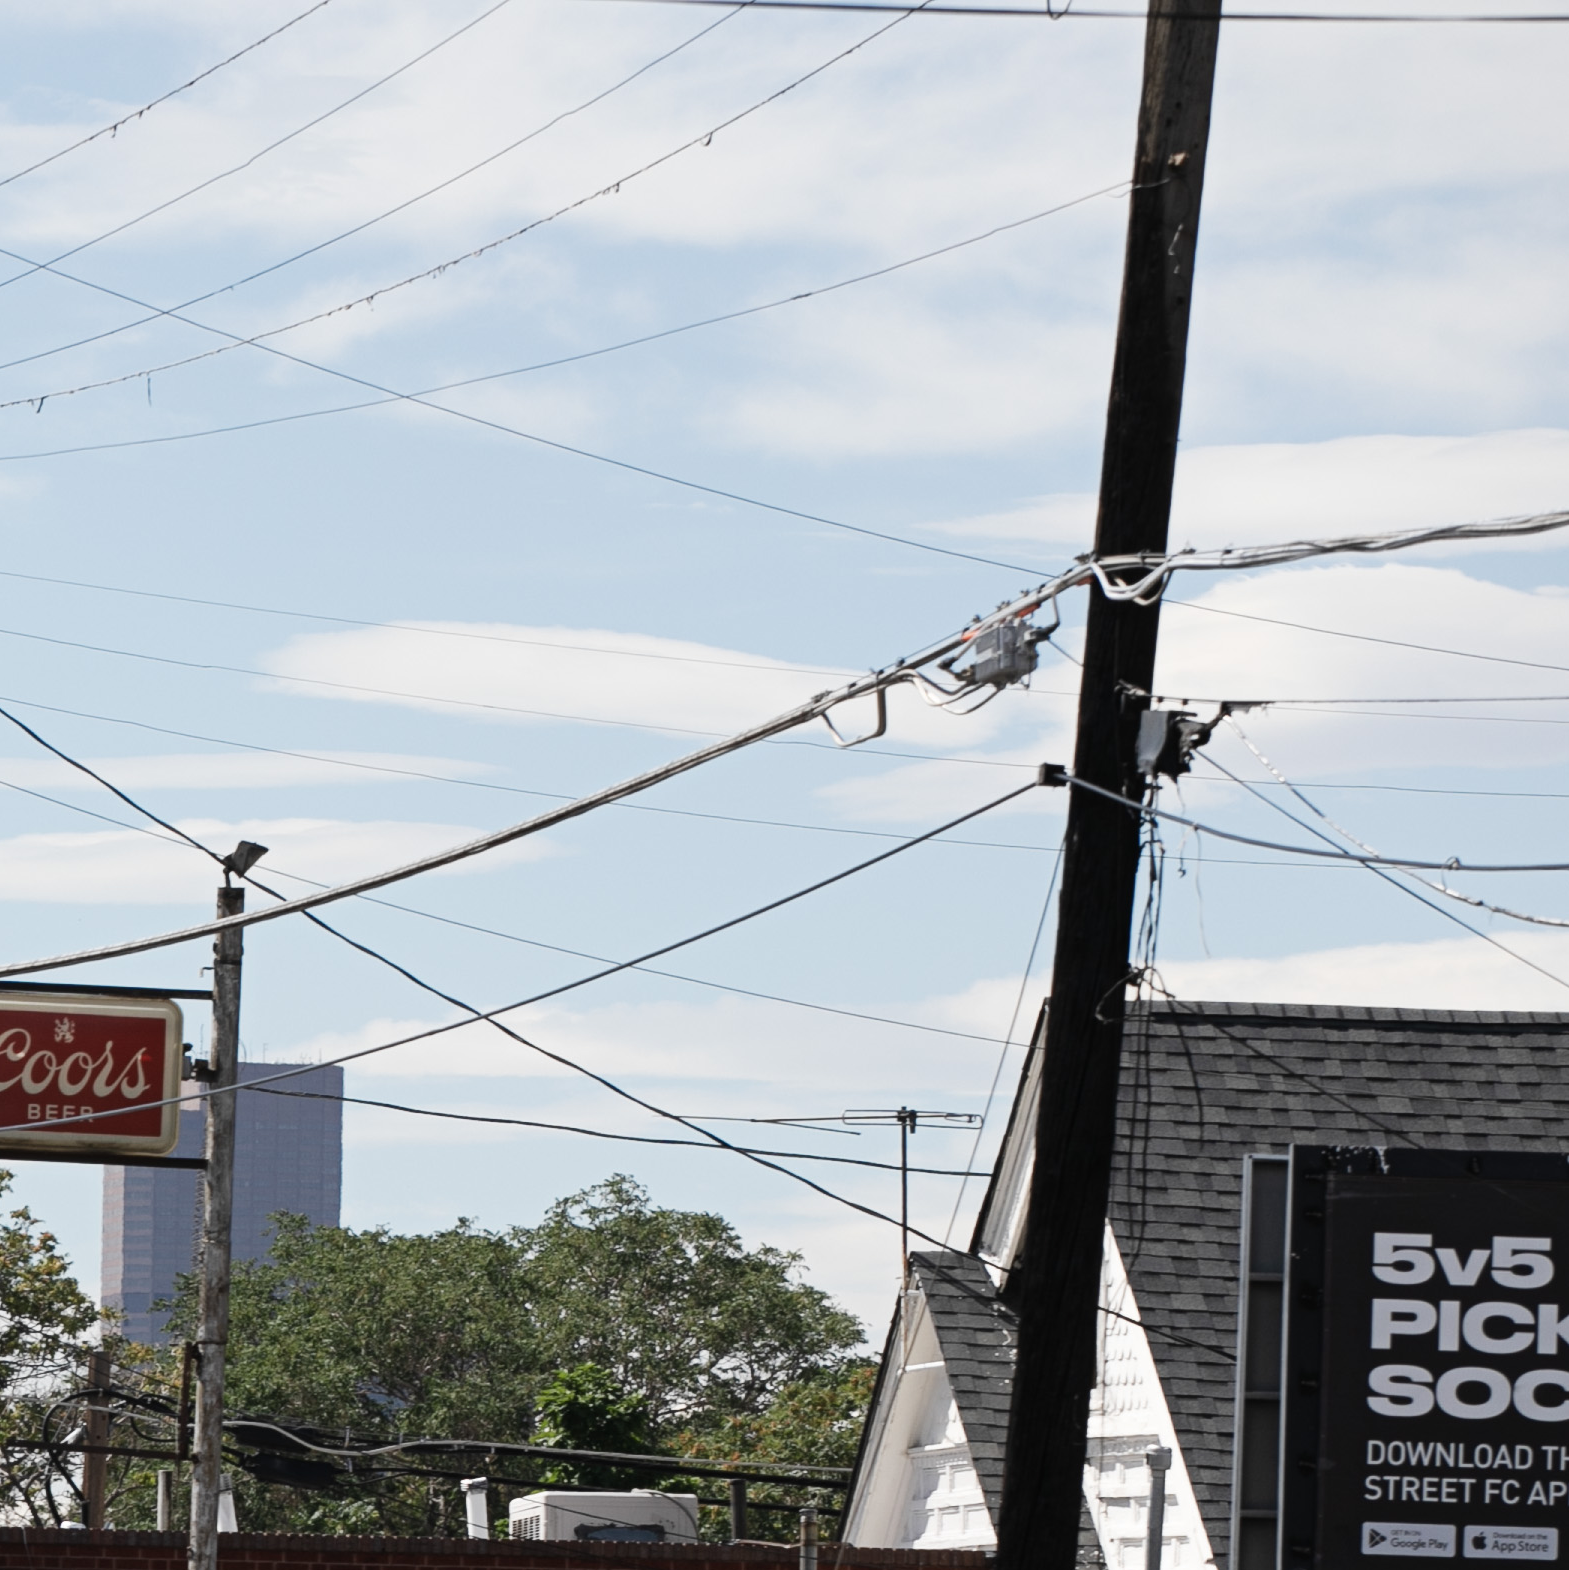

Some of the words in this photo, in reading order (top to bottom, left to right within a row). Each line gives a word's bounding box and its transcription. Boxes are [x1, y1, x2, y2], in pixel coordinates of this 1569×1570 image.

[27, 1104, 93, 1122] BEER
[1372, 1232, 1555, 1289] 5v5
[1367, 1440, 1533, 1470] DOWNLOAD
[1364, 1476, 1476, 1504] STREET
[1485, 1479, 1520, 1505] FC
[1528, 1481, 1569, 1506] AP
[1390, 1538, 1427, 1551] Google
[1429, 1539, 1448, 1551] Play
[1493, 1532, 1526, 1540] Download
[1492, 1540, 1512, 1553] App
[1518, 1542, 1549, 1552] Store
